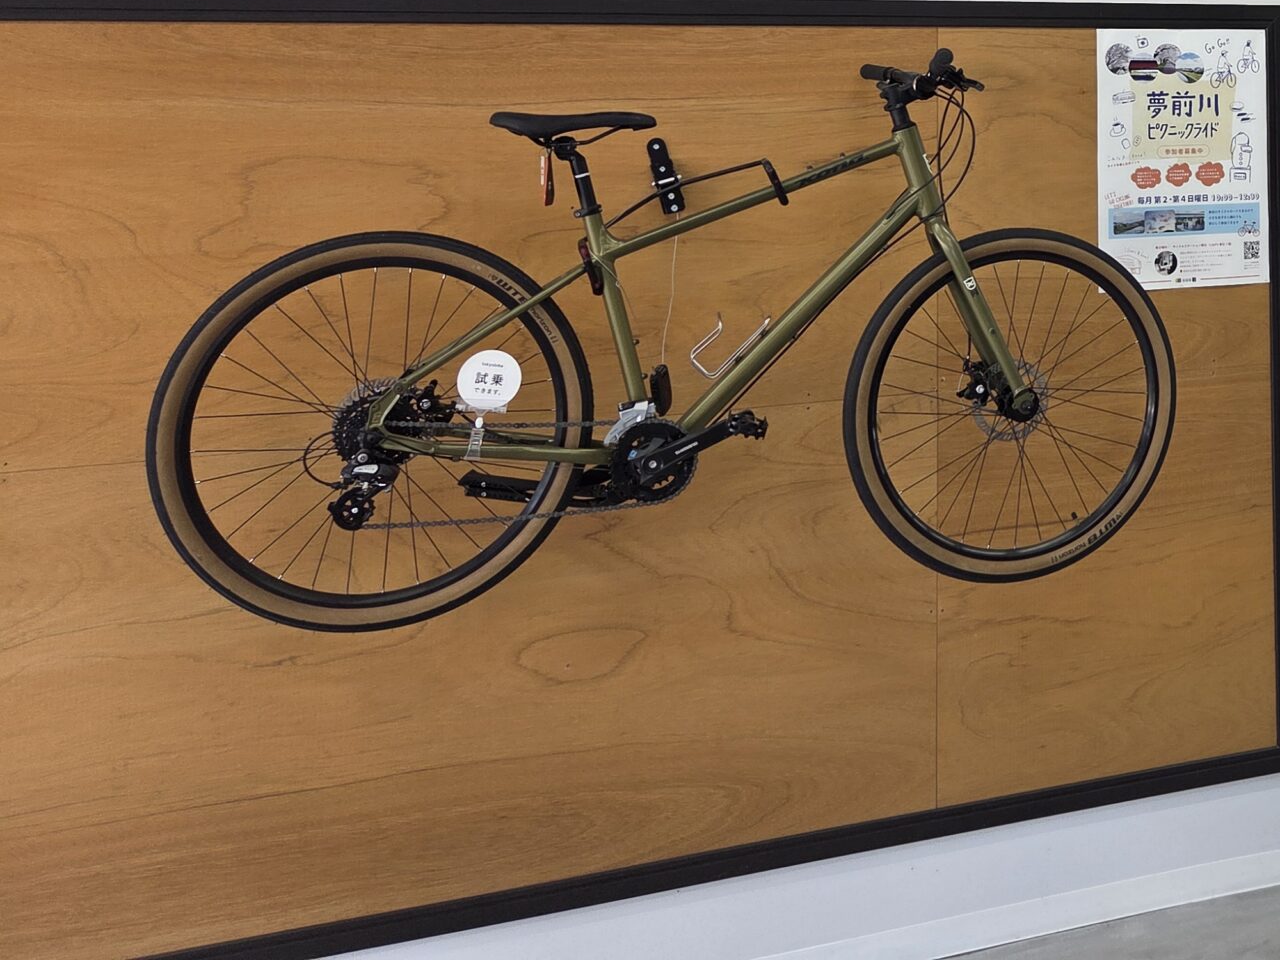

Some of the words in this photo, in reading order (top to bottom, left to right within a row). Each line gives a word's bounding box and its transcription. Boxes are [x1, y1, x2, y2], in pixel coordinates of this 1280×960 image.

[1146, 90, 1220, 119] 夢前川
[1147, 121, 1220, 140] ピクニックライド
[1137, 196, 1152, 205] 毎月
[474, 372, 504, 386] 試乗
[474, 387, 501, 396] できます。
